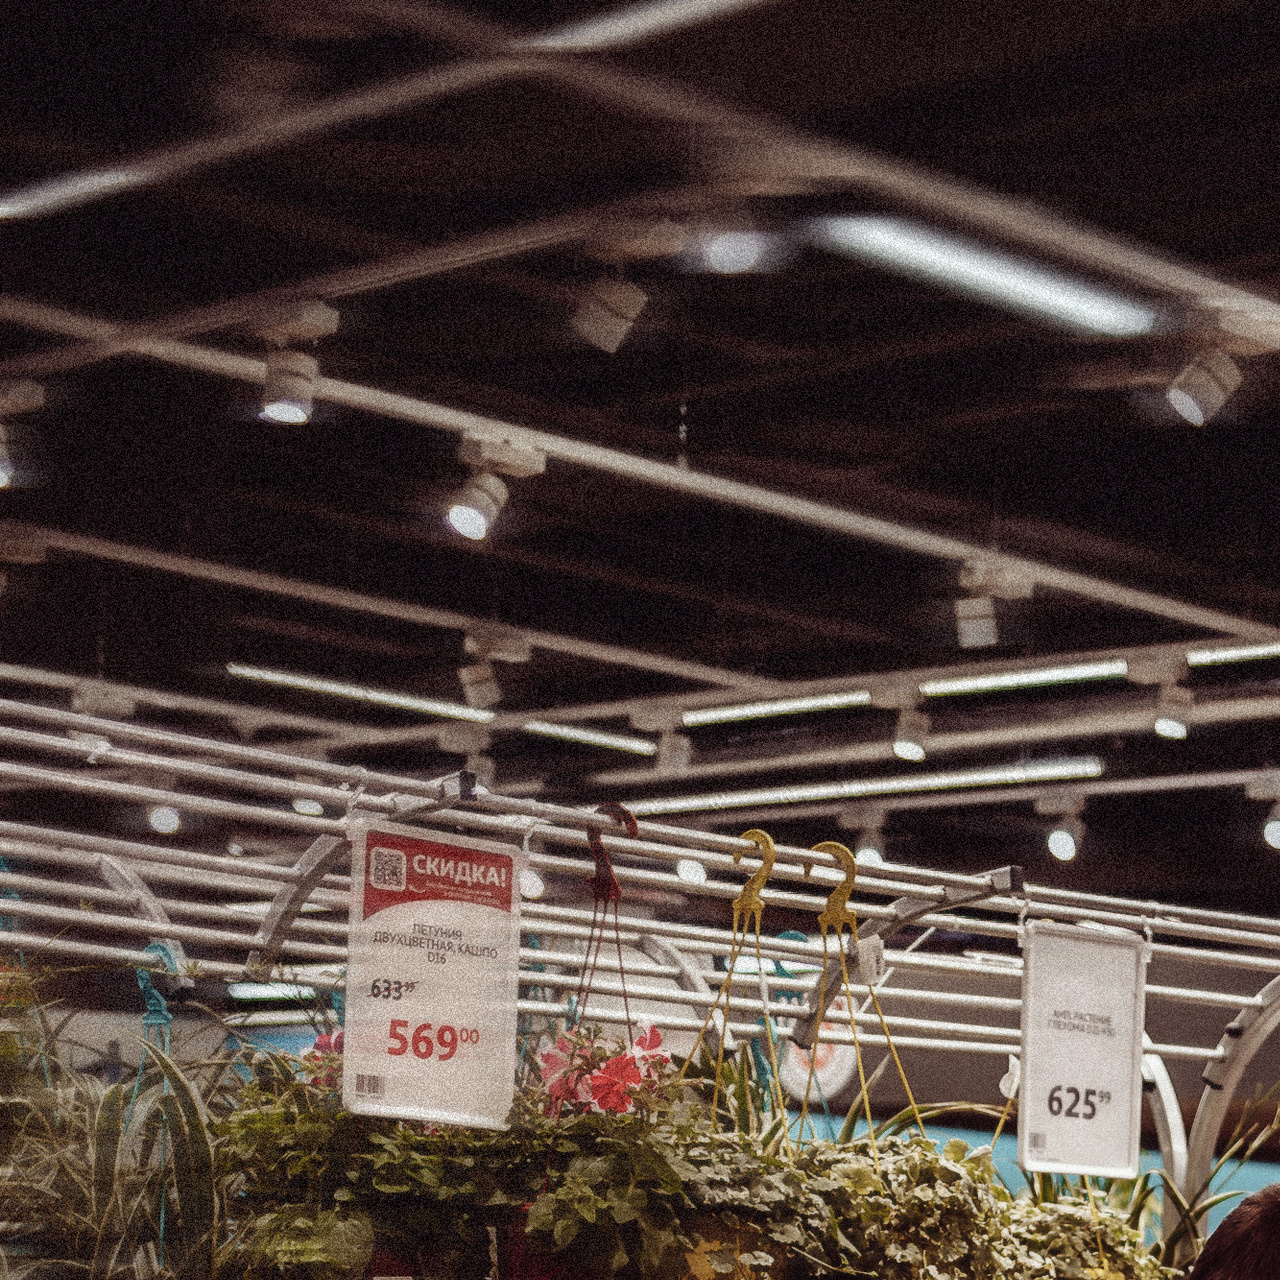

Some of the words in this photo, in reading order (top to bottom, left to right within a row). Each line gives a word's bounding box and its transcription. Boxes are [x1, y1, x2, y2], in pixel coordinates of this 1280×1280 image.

[413, 855, 506, 887] СКИДКА!
[413, 923, 462, 940] ПЕТУНИЯ
[458, 942, 498, 959] КАШПО
